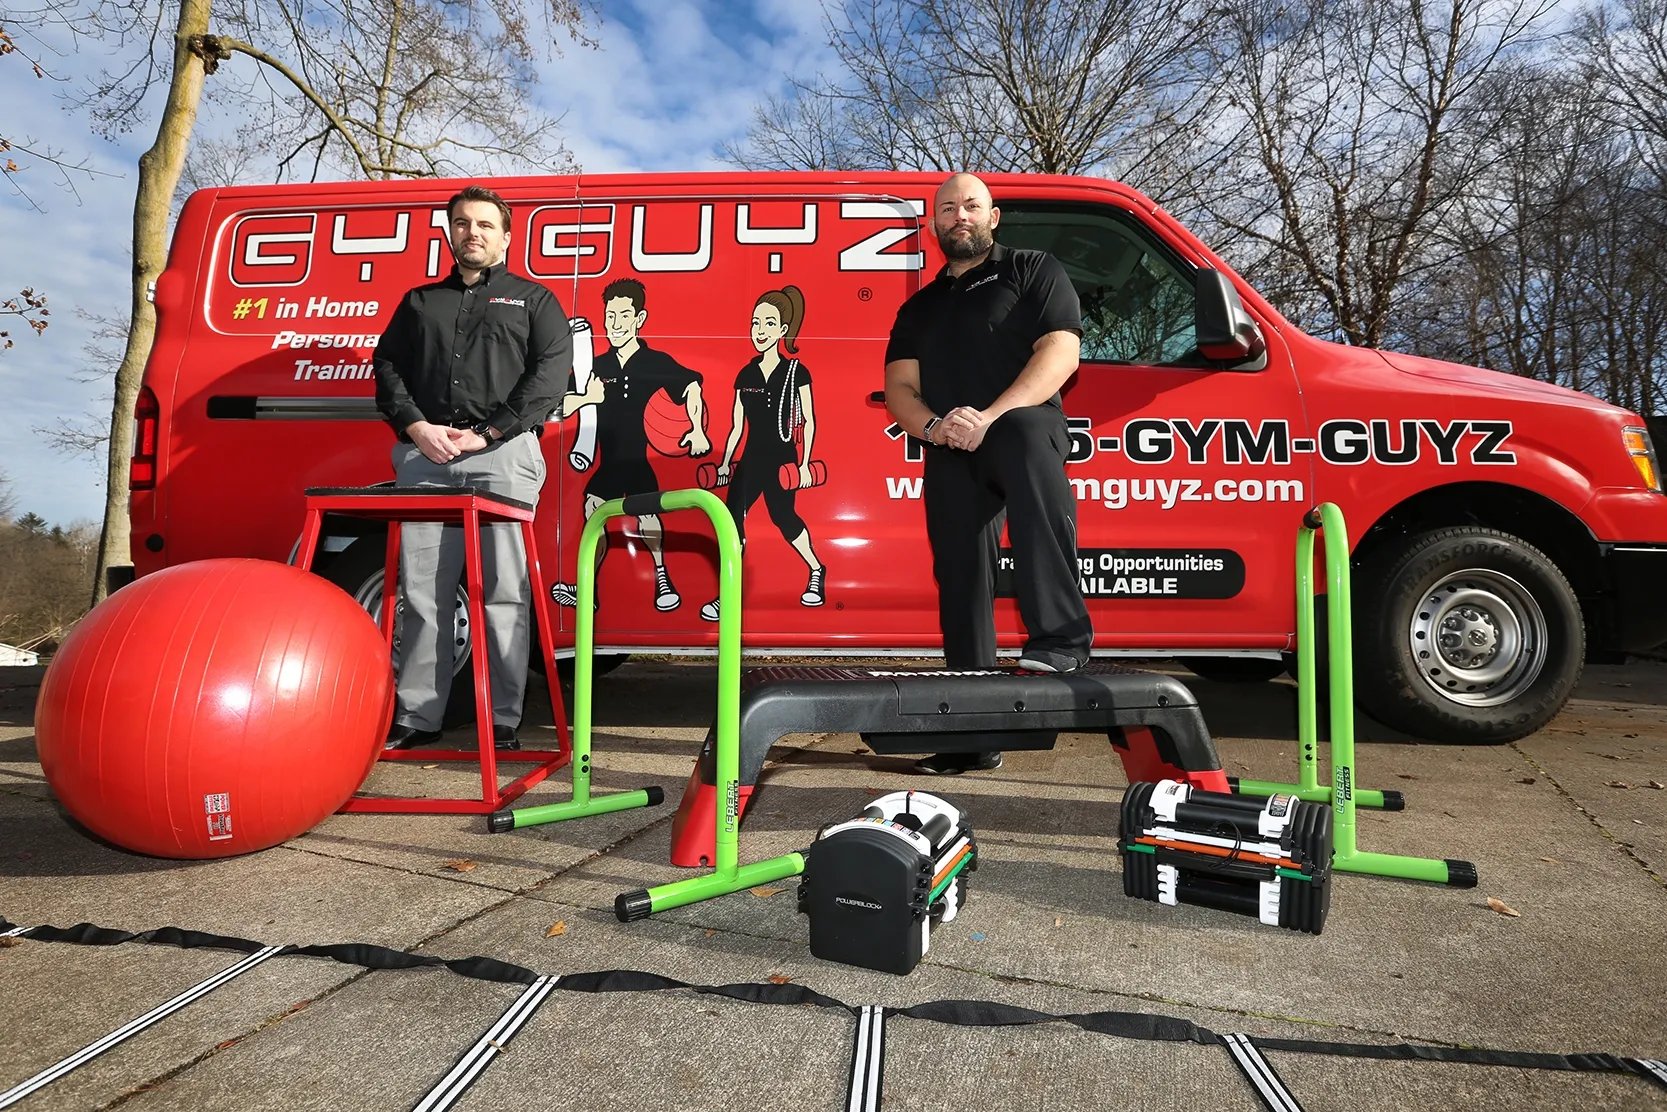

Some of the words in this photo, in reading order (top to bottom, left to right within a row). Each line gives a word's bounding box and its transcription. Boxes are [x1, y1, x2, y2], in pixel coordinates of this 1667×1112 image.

[232, 298, 269, 320] #1
[275, 297, 299, 319] in
[305, 296, 380, 318] Home
[271, 331, 381, 350] Persona
[884, 417, 1518, 466] 15-GYM-GUYZ
[886, 477, 1304, 511] wmguyz.com
[1099, 553, 1224, 575] Opportunities
[1081, 577, 1179, 594] ILABLE
[1335, 765, 1345, 814] LEBERT
[1343, 768, 1351, 799] FITNESS
[725, 781, 735, 832] LEBERT
[835, 896, 880, 909] POWERBLOCK
